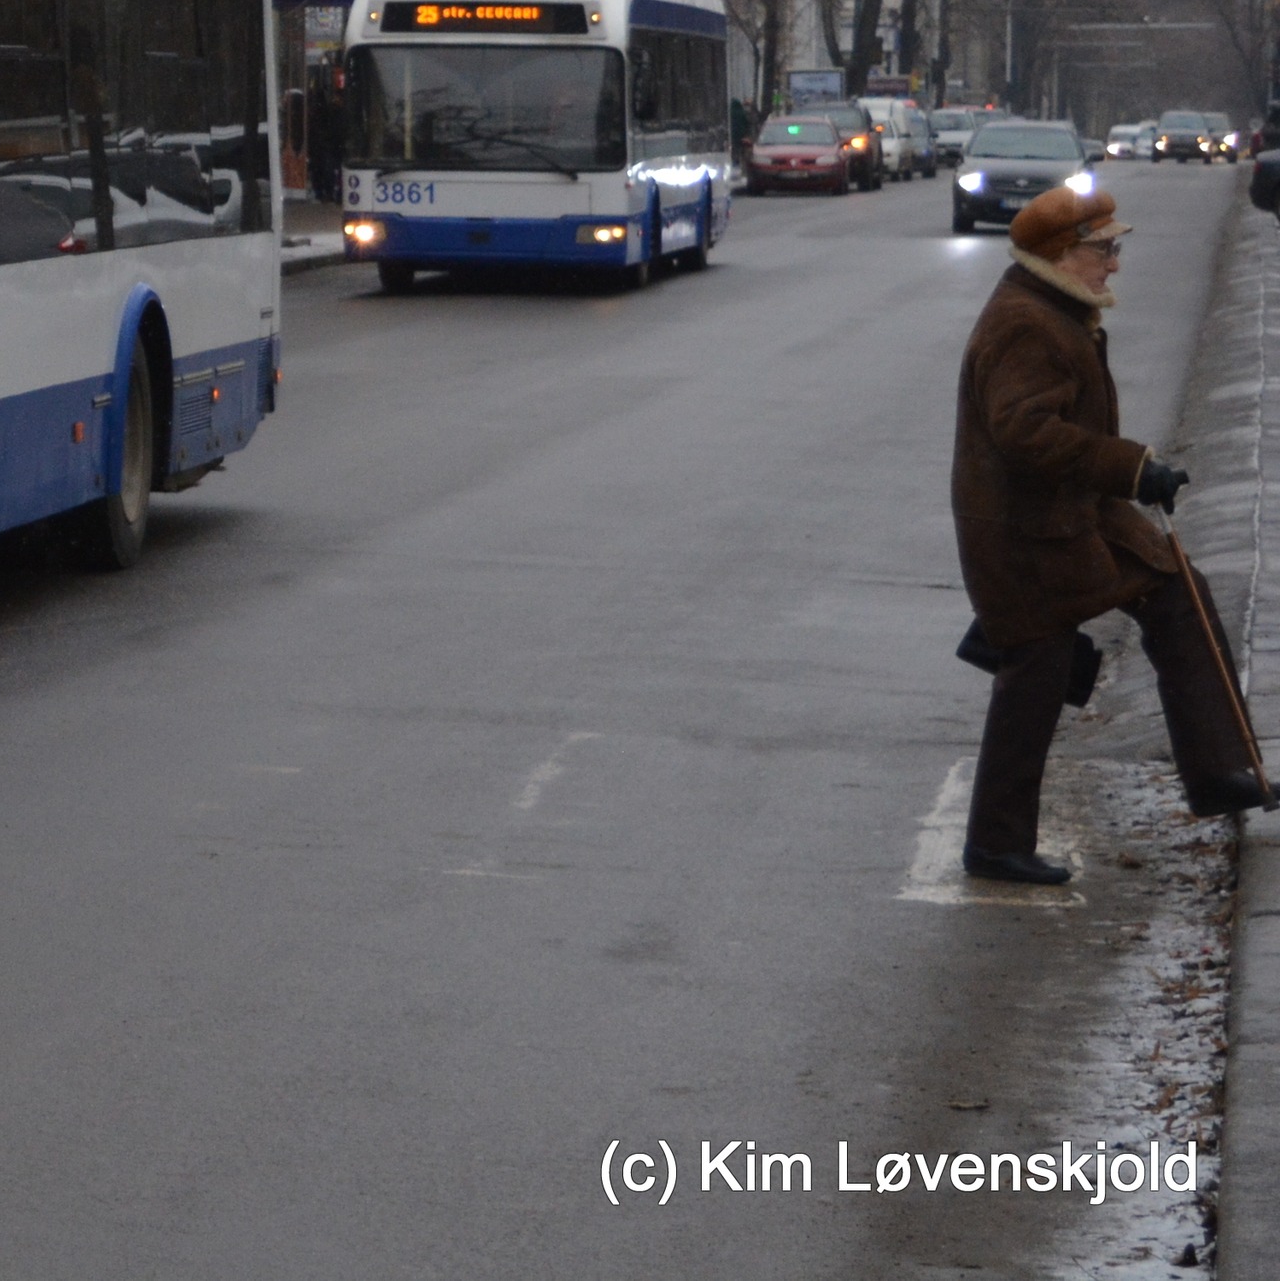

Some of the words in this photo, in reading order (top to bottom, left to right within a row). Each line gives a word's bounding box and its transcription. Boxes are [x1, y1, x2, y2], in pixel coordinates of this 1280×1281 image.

[417, 5, 438, 24] 25
[442, 6, 472, 19] str.
[376, 181, 435, 205] 3861
